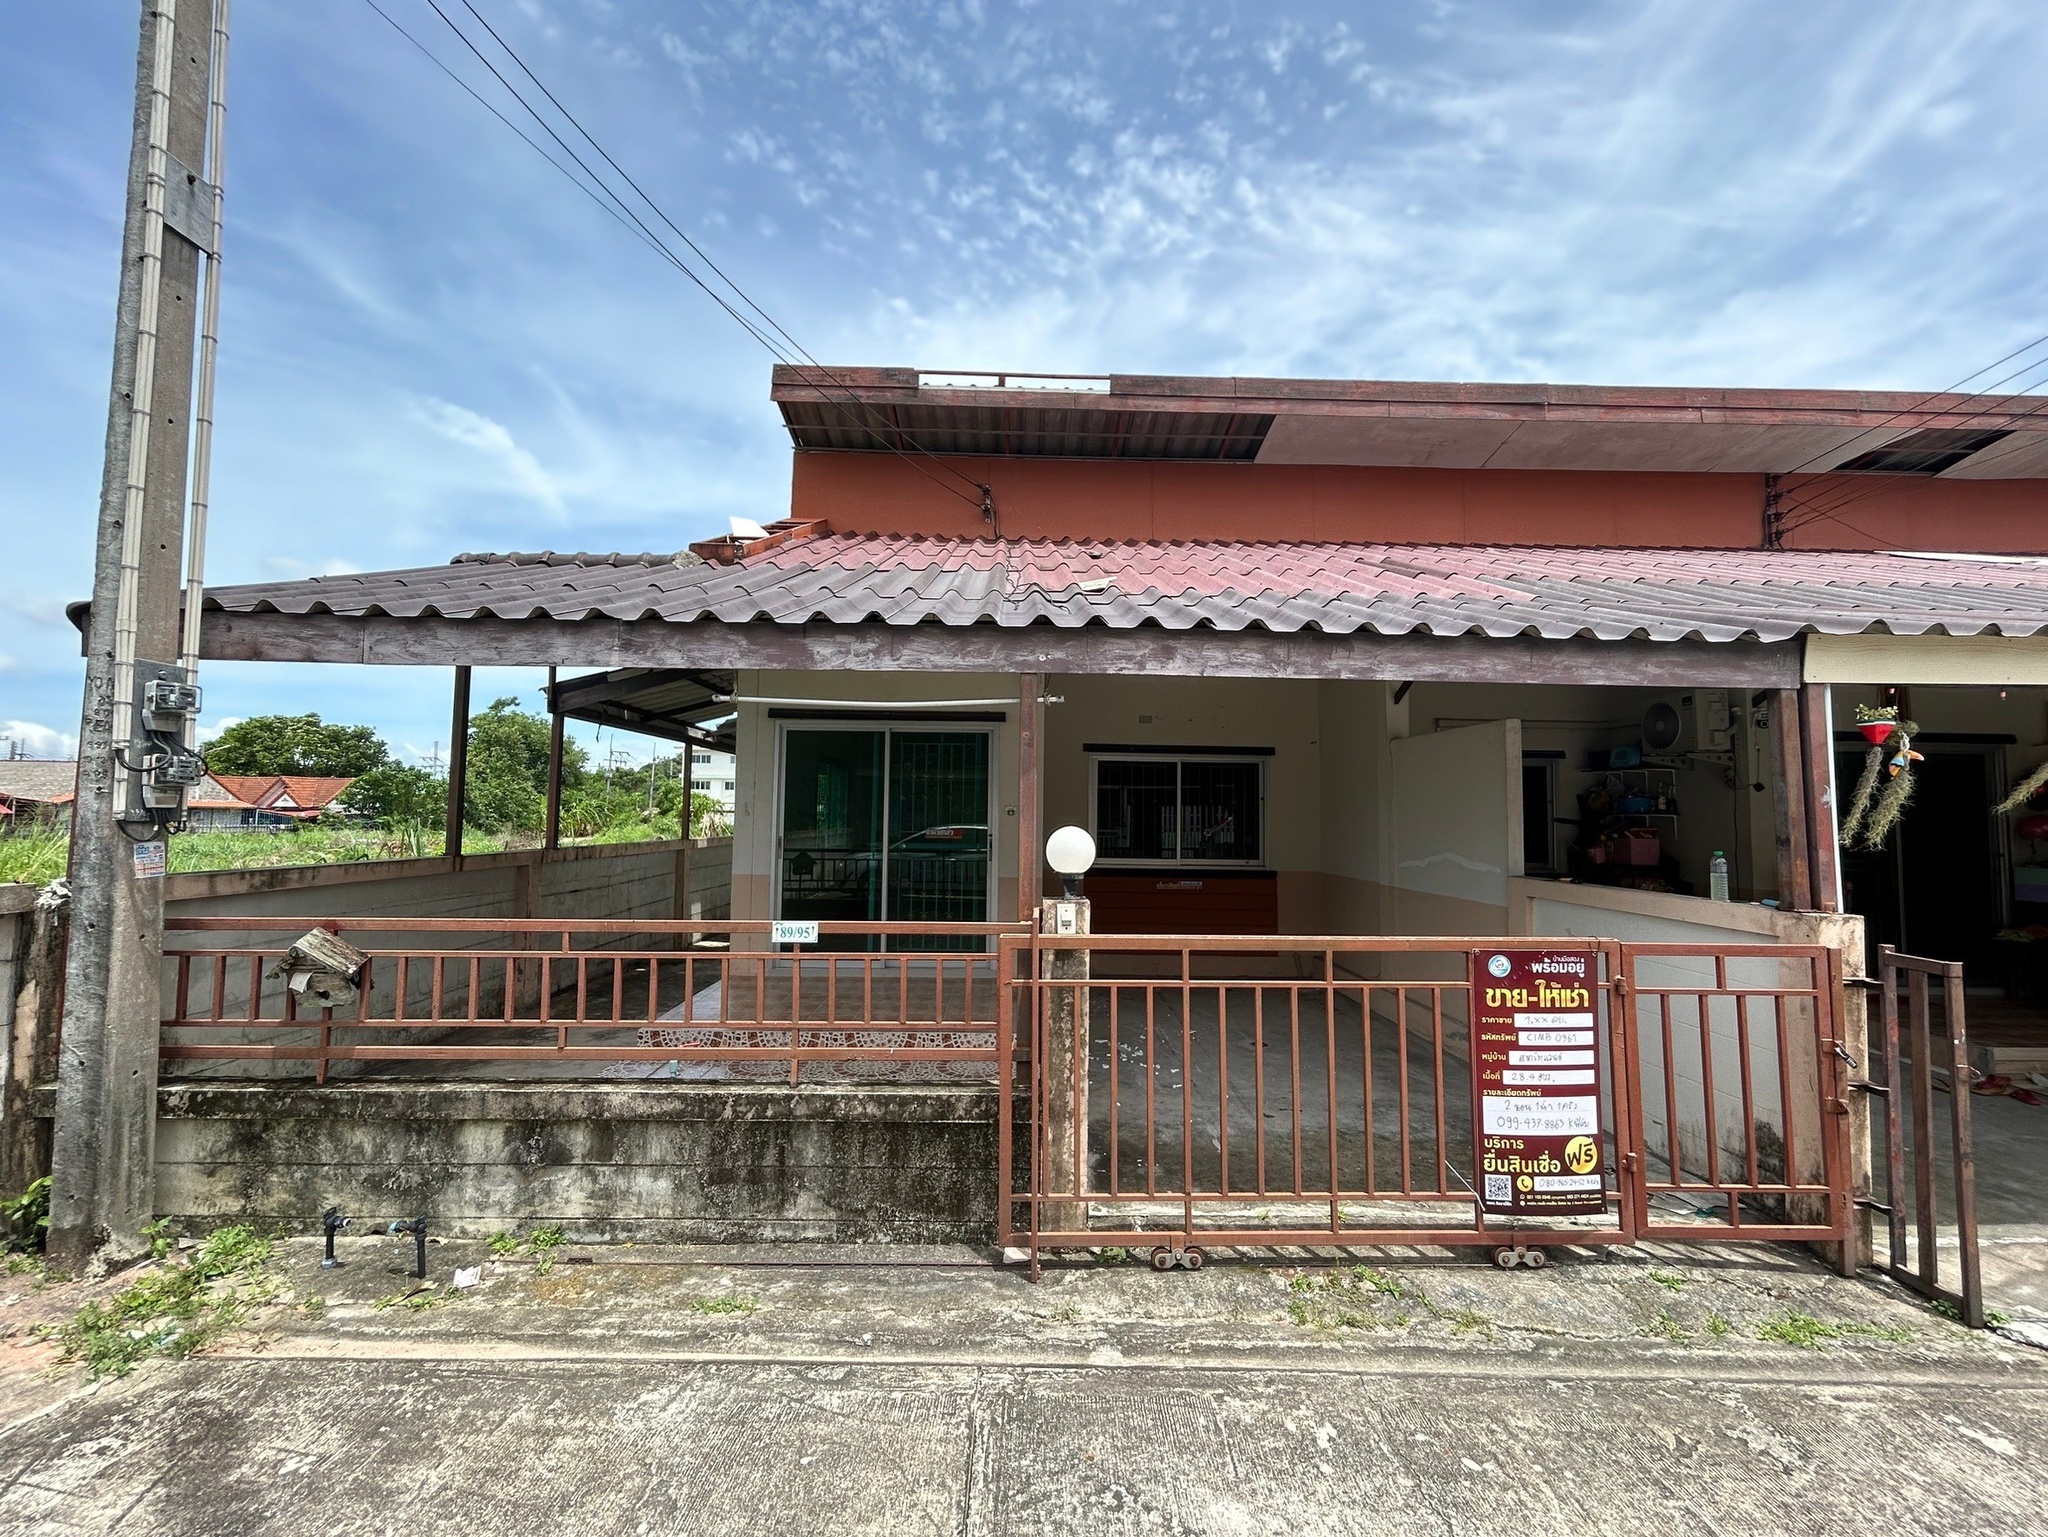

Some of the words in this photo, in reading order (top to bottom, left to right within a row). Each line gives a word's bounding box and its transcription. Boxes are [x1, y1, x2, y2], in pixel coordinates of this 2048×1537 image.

[780, 926, 811, 939] 89/95
[1531, 958, 1585, 978] พร้อมอยู่
[1485, 979, 1589, 1008] ขาย-ให้เช่า
[1481, 1016, 1512, 1024] ราคาขาย
[1481, 1032, 1516, 1041] รหัสทรัพย์
[1526, 1033, 1551, 1042] CIMB
[1481, 1052, 1507, 1063] หมู่บ้าน
[1482, 1070, 1500, 1080] เนื้อที่
[1483, 1089, 1542, 1097] รายละเอียดทรัพย์
[1504, 1099, 1511, 1110] 2
[1484, 1136, 1525, 1150] บริการ
[1567, 1143, 1594, 1167] ฟรี
[1483, 1149, 1561, 1173] ยื่นสินเชื่อ
